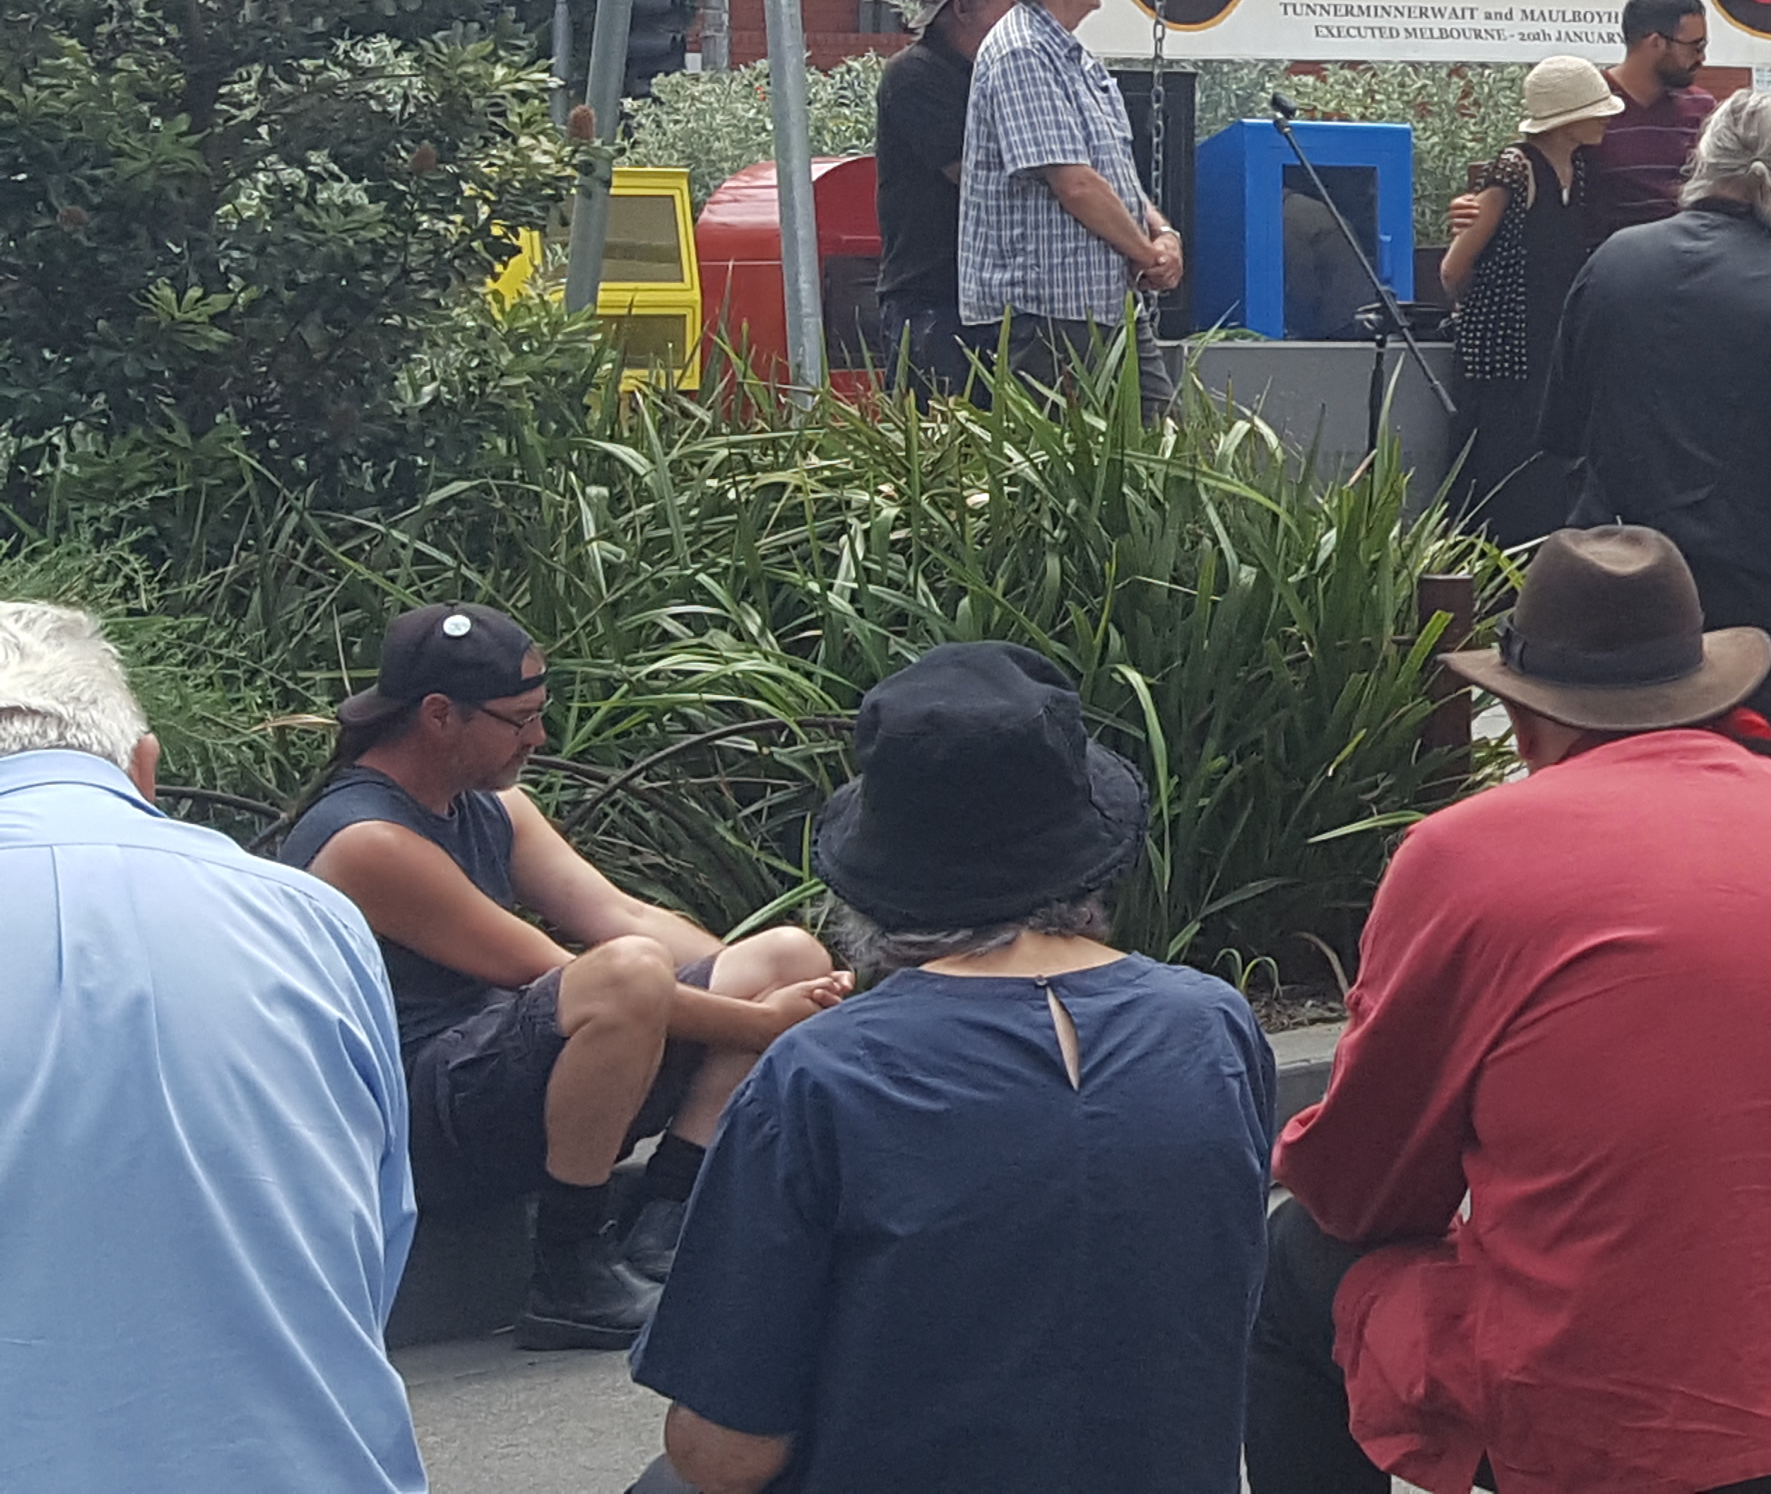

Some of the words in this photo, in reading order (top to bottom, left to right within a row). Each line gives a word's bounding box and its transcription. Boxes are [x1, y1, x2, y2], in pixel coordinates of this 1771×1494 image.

[1279, 1, 1479, 22] TUNNERMINNERWAIT
[1484, 7, 1514, 22] and
[1519, 8, 1620, 25] MAULBOYH
[1314, 24, 1401, 40] EXECUTED
[1404, 25, 1507, 42] MELBOURNE
[1518, 29, 1552, 43] 20th
[1555, 30, 1627, 45] JANUARY
